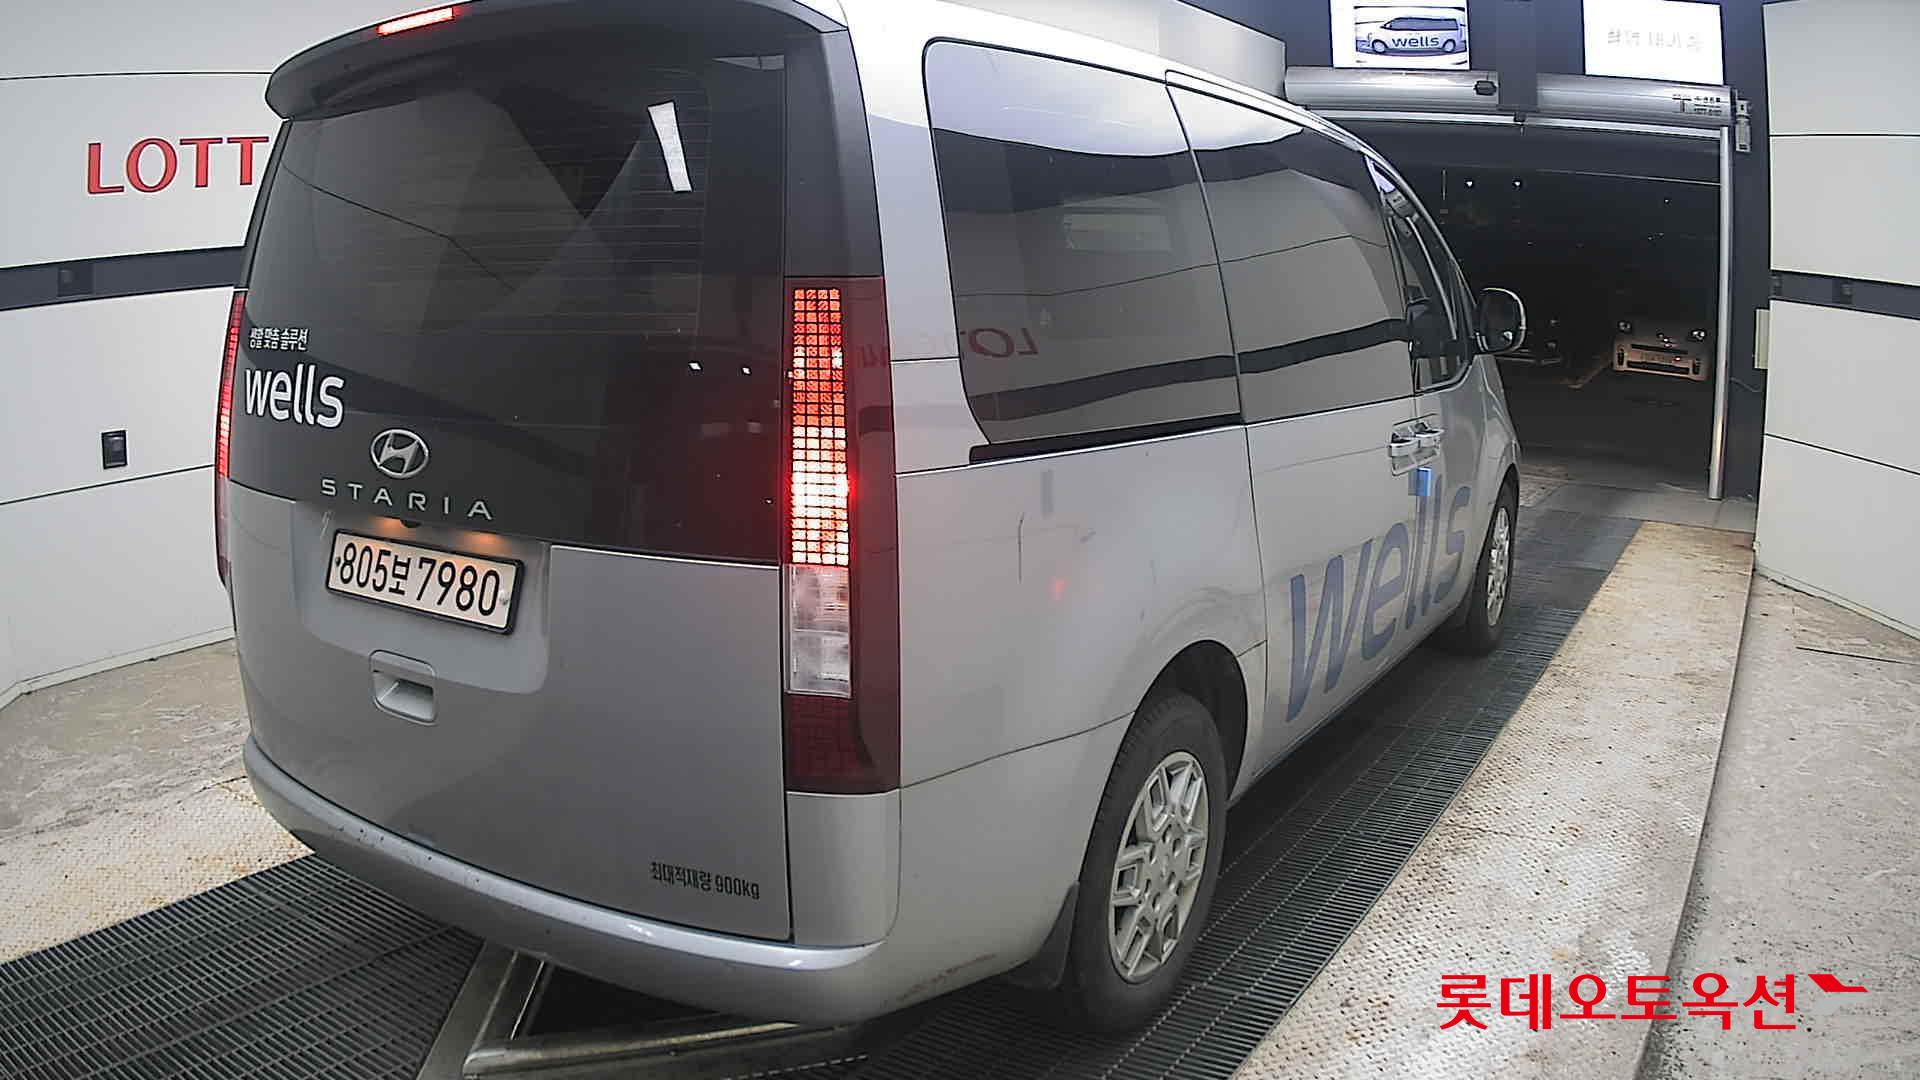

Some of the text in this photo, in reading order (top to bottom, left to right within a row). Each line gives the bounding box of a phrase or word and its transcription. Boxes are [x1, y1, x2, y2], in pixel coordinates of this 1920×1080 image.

[1391, 36, 1440, 48] wells
[87, 136, 270, 195] LOTT
[264, 328, 280, 350] 맞춤
[280, 328, 309, 351] 솔루션
[244, 363, 345, 428] wells
[320, 478, 493, 521] STARIA
[1286, 474, 1472, 723] wells
[651, 861, 712, 891] 최대적재량
